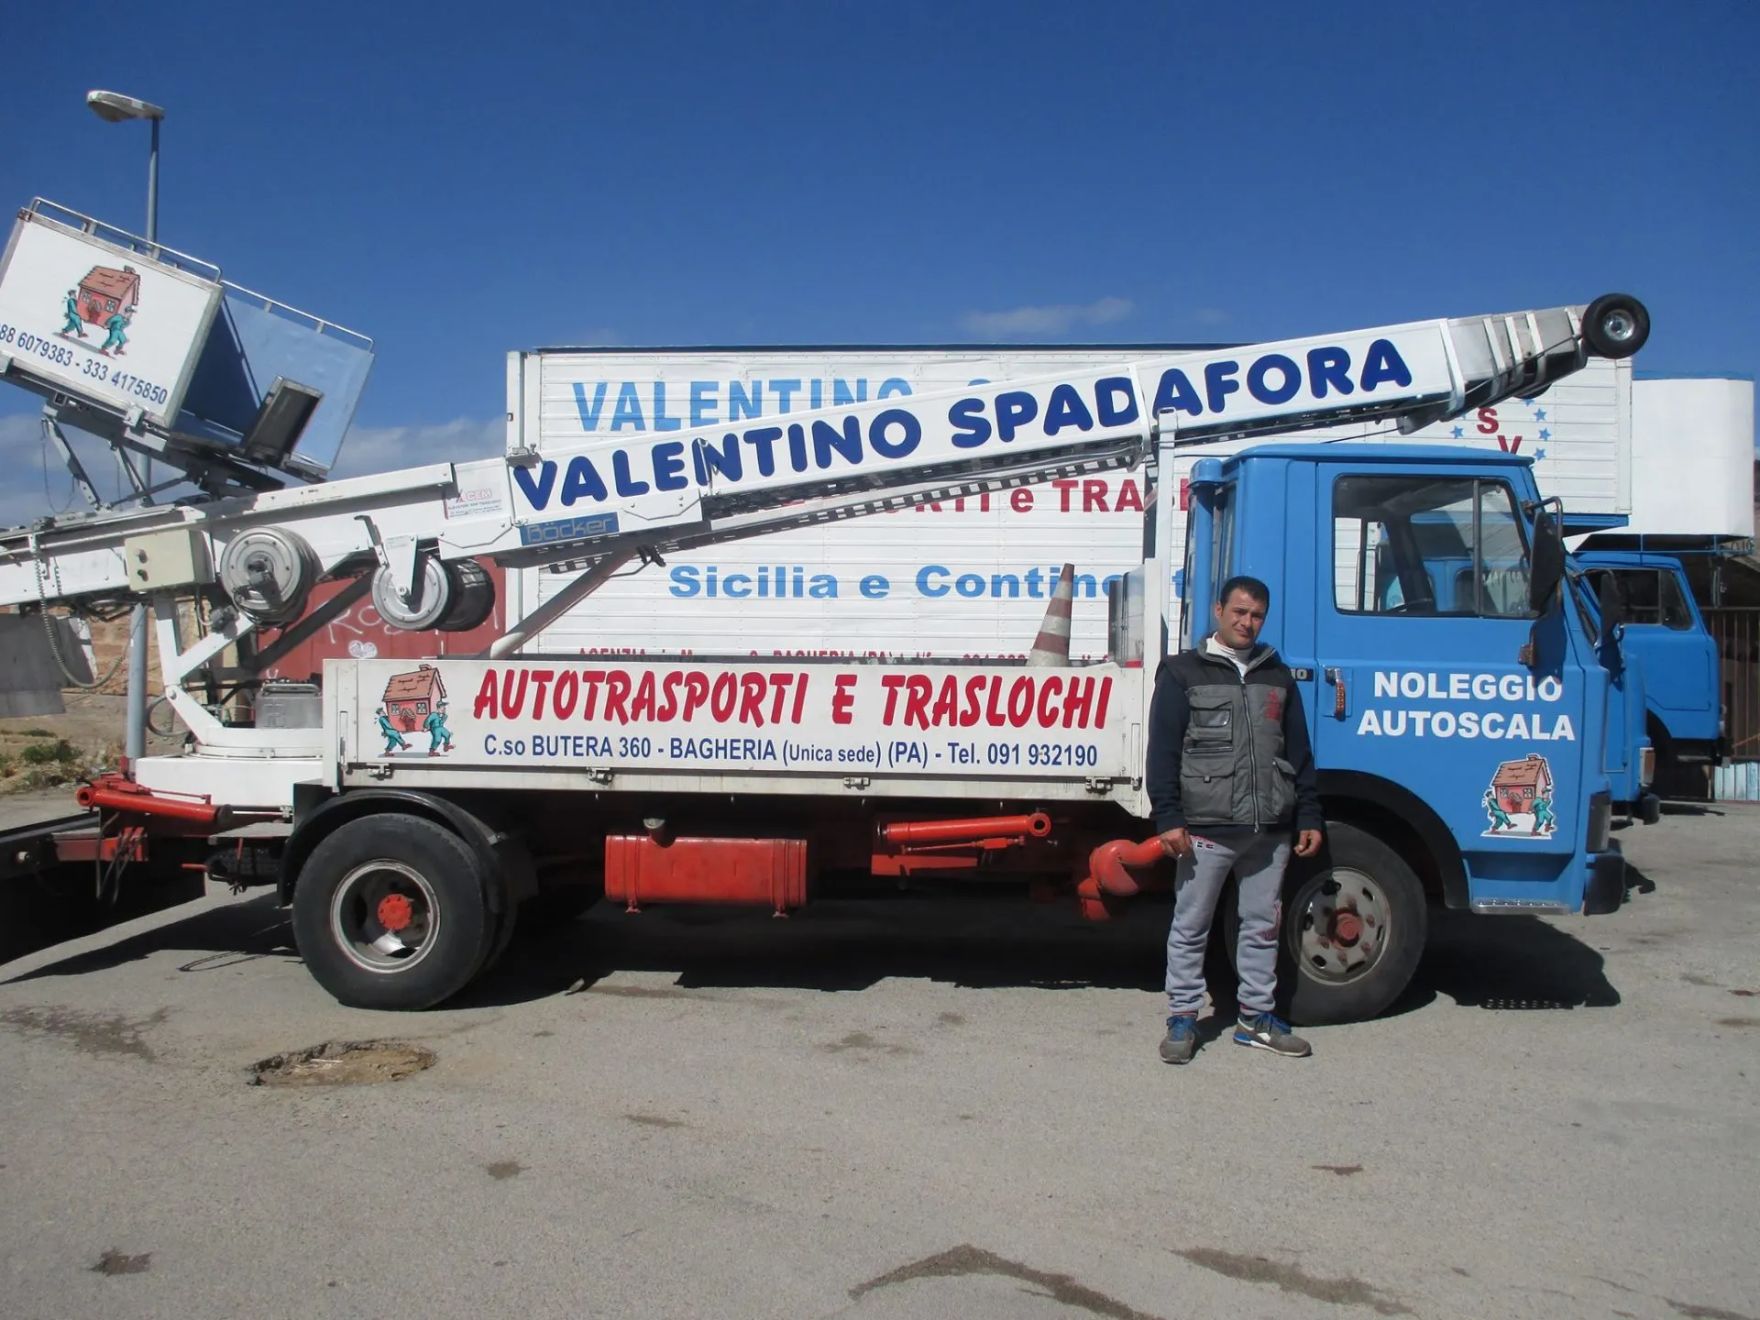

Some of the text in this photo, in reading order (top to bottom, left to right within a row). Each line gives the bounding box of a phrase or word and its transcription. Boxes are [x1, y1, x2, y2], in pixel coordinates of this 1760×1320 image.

[0, 324, 16, 343] 88
[17, 332, 73, 366] 6079383
[83, 358, 108, 381] 333
[111, 371, 168, 405] 4175850
[513, 339, 1412, 511] VALENTINO SPADAFORA
[1010, 487, 1034, 513] e
[526, 518, 613, 543] Böcker
[669, 565, 838, 599] Sicilia
[859, 575, 890, 599] e
[473, 668, 1113, 731] AUTOTRASPORTI E TRASLOCHI
[1374, 671, 1563, 702] NOLEGGIO
[1357, 709, 1575, 741] AUTOSCALA
[484, 734, 526, 756] C.so
[532, 735, 614, 757] BUTERA
[618, 736, 651, 758] 360
[670, 737, 777, 761] BAGHERIA
[782, 738, 833, 767] (Unica
[838, 741, 882, 769] sede)
[888, 741, 928, 769] (PA)
[947, 741, 981, 765] Tel.
[987, 742, 1020, 766] 091
[1028, 743, 1098, 768] 932190
